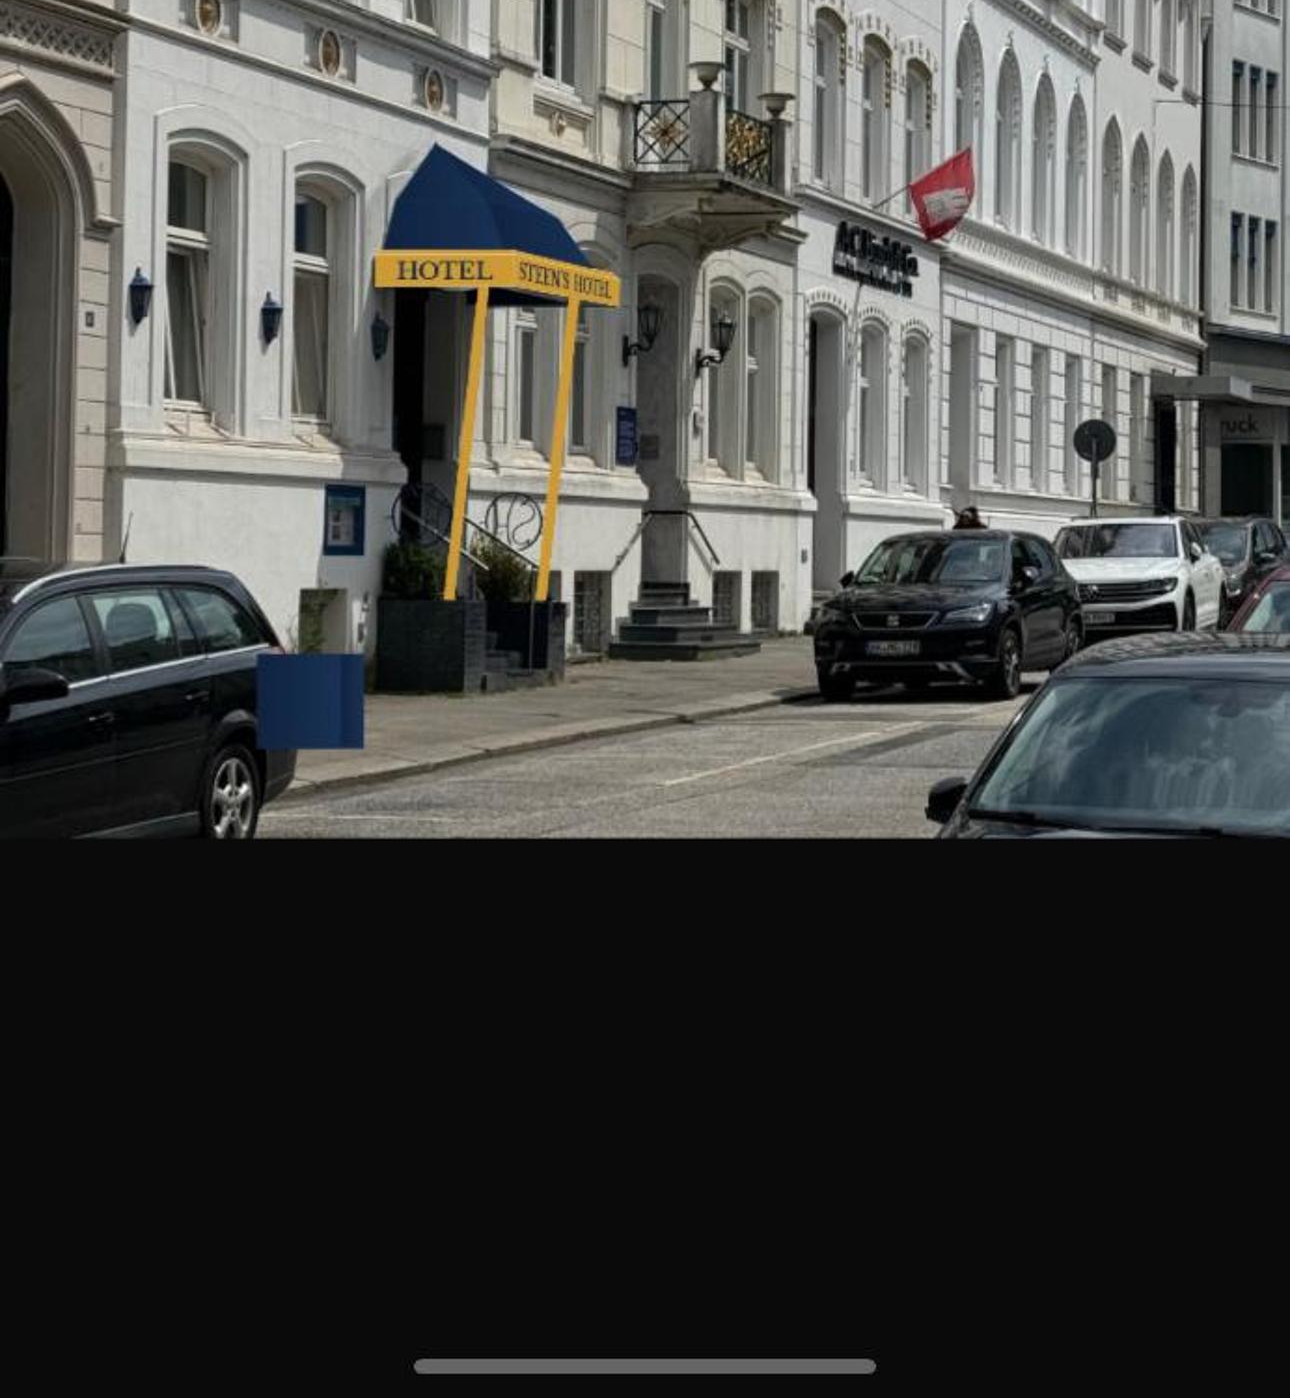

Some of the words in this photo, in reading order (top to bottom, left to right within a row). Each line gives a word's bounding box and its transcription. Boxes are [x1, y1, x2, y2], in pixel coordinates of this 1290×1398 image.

[396, 259, 493, 281] HOTEL
[518, 262, 571, 290] STEEN'S
[573, 274, 612, 299] HOTEL
